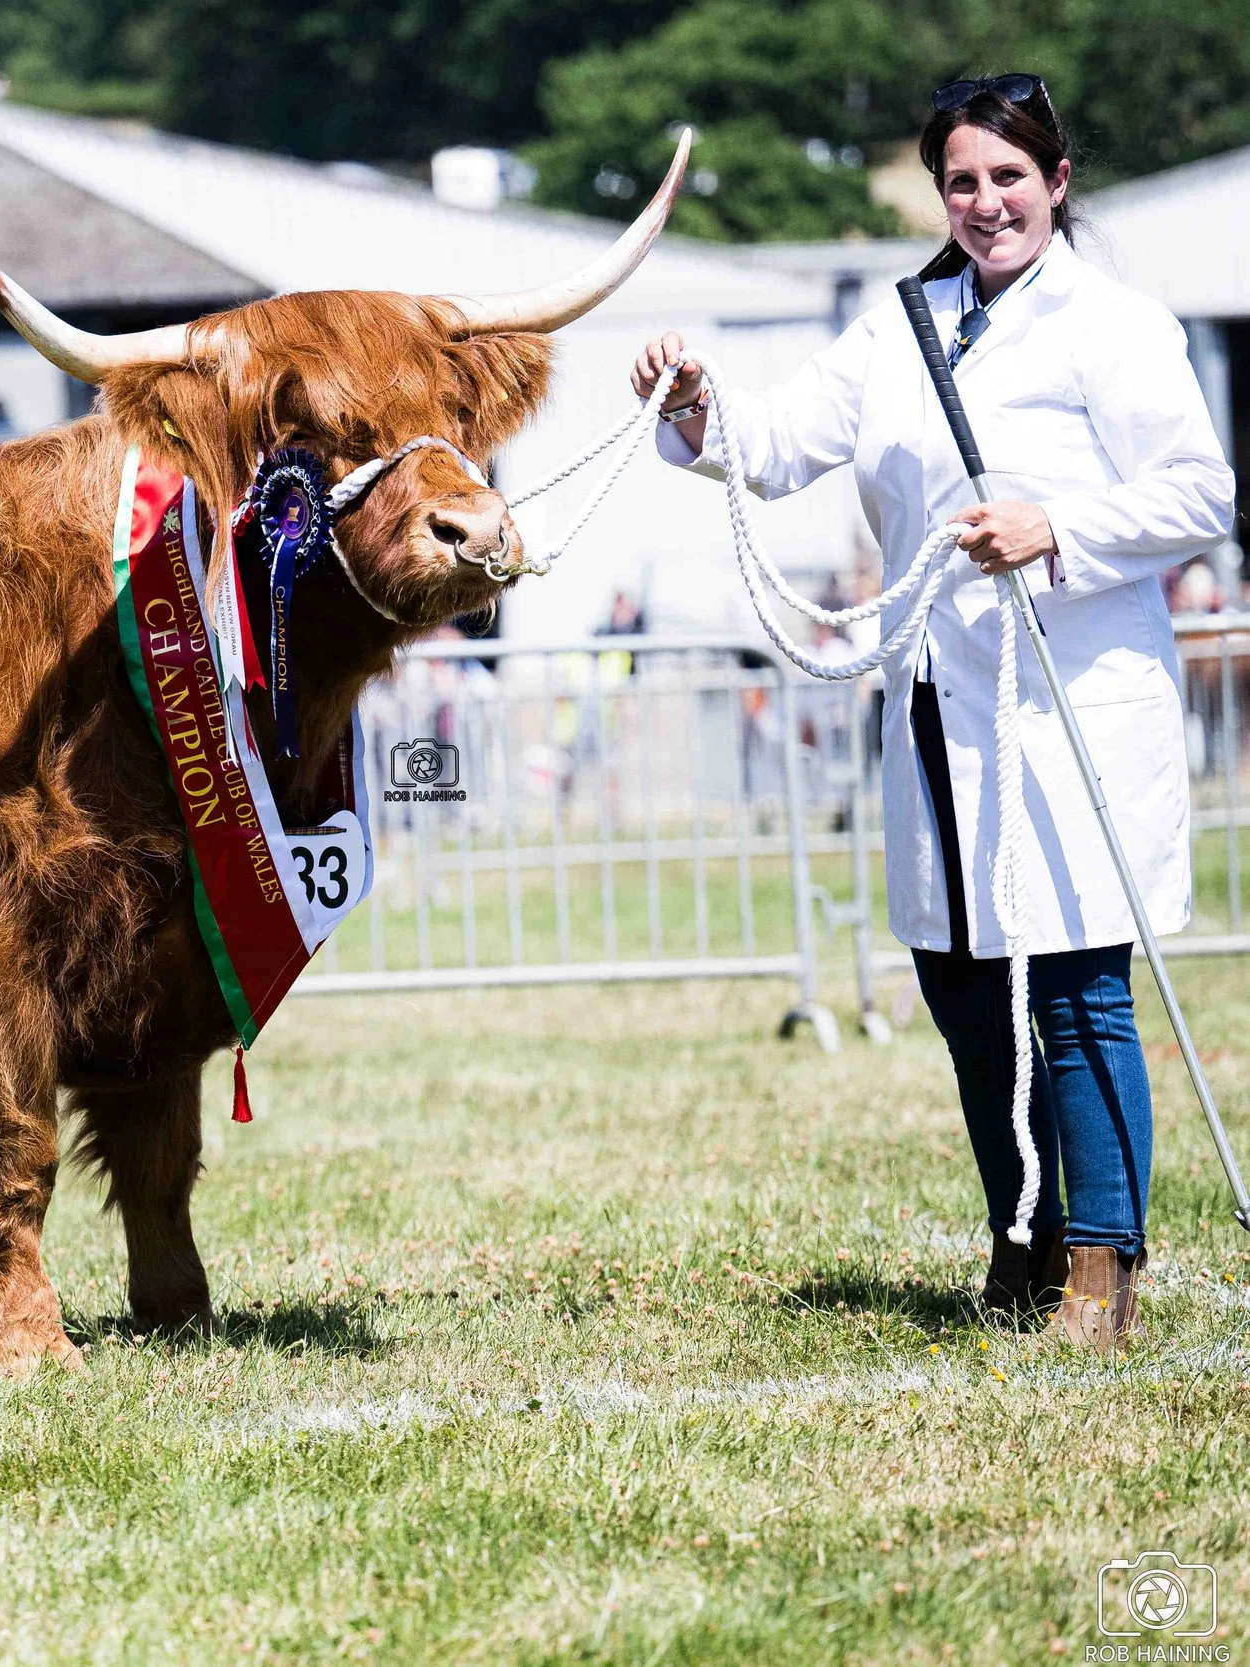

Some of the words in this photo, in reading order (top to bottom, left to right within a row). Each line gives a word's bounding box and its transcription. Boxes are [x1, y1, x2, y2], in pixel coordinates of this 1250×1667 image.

[165, 538, 206, 653] HIGHLAND
[275, 585, 288, 691] CHAMPION
[144, 598, 227, 828] CHAMPION
[193, 657, 225, 739] CATTLE
[235, 803, 258, 830] OF
[246, 833, 283, 904] WALES
